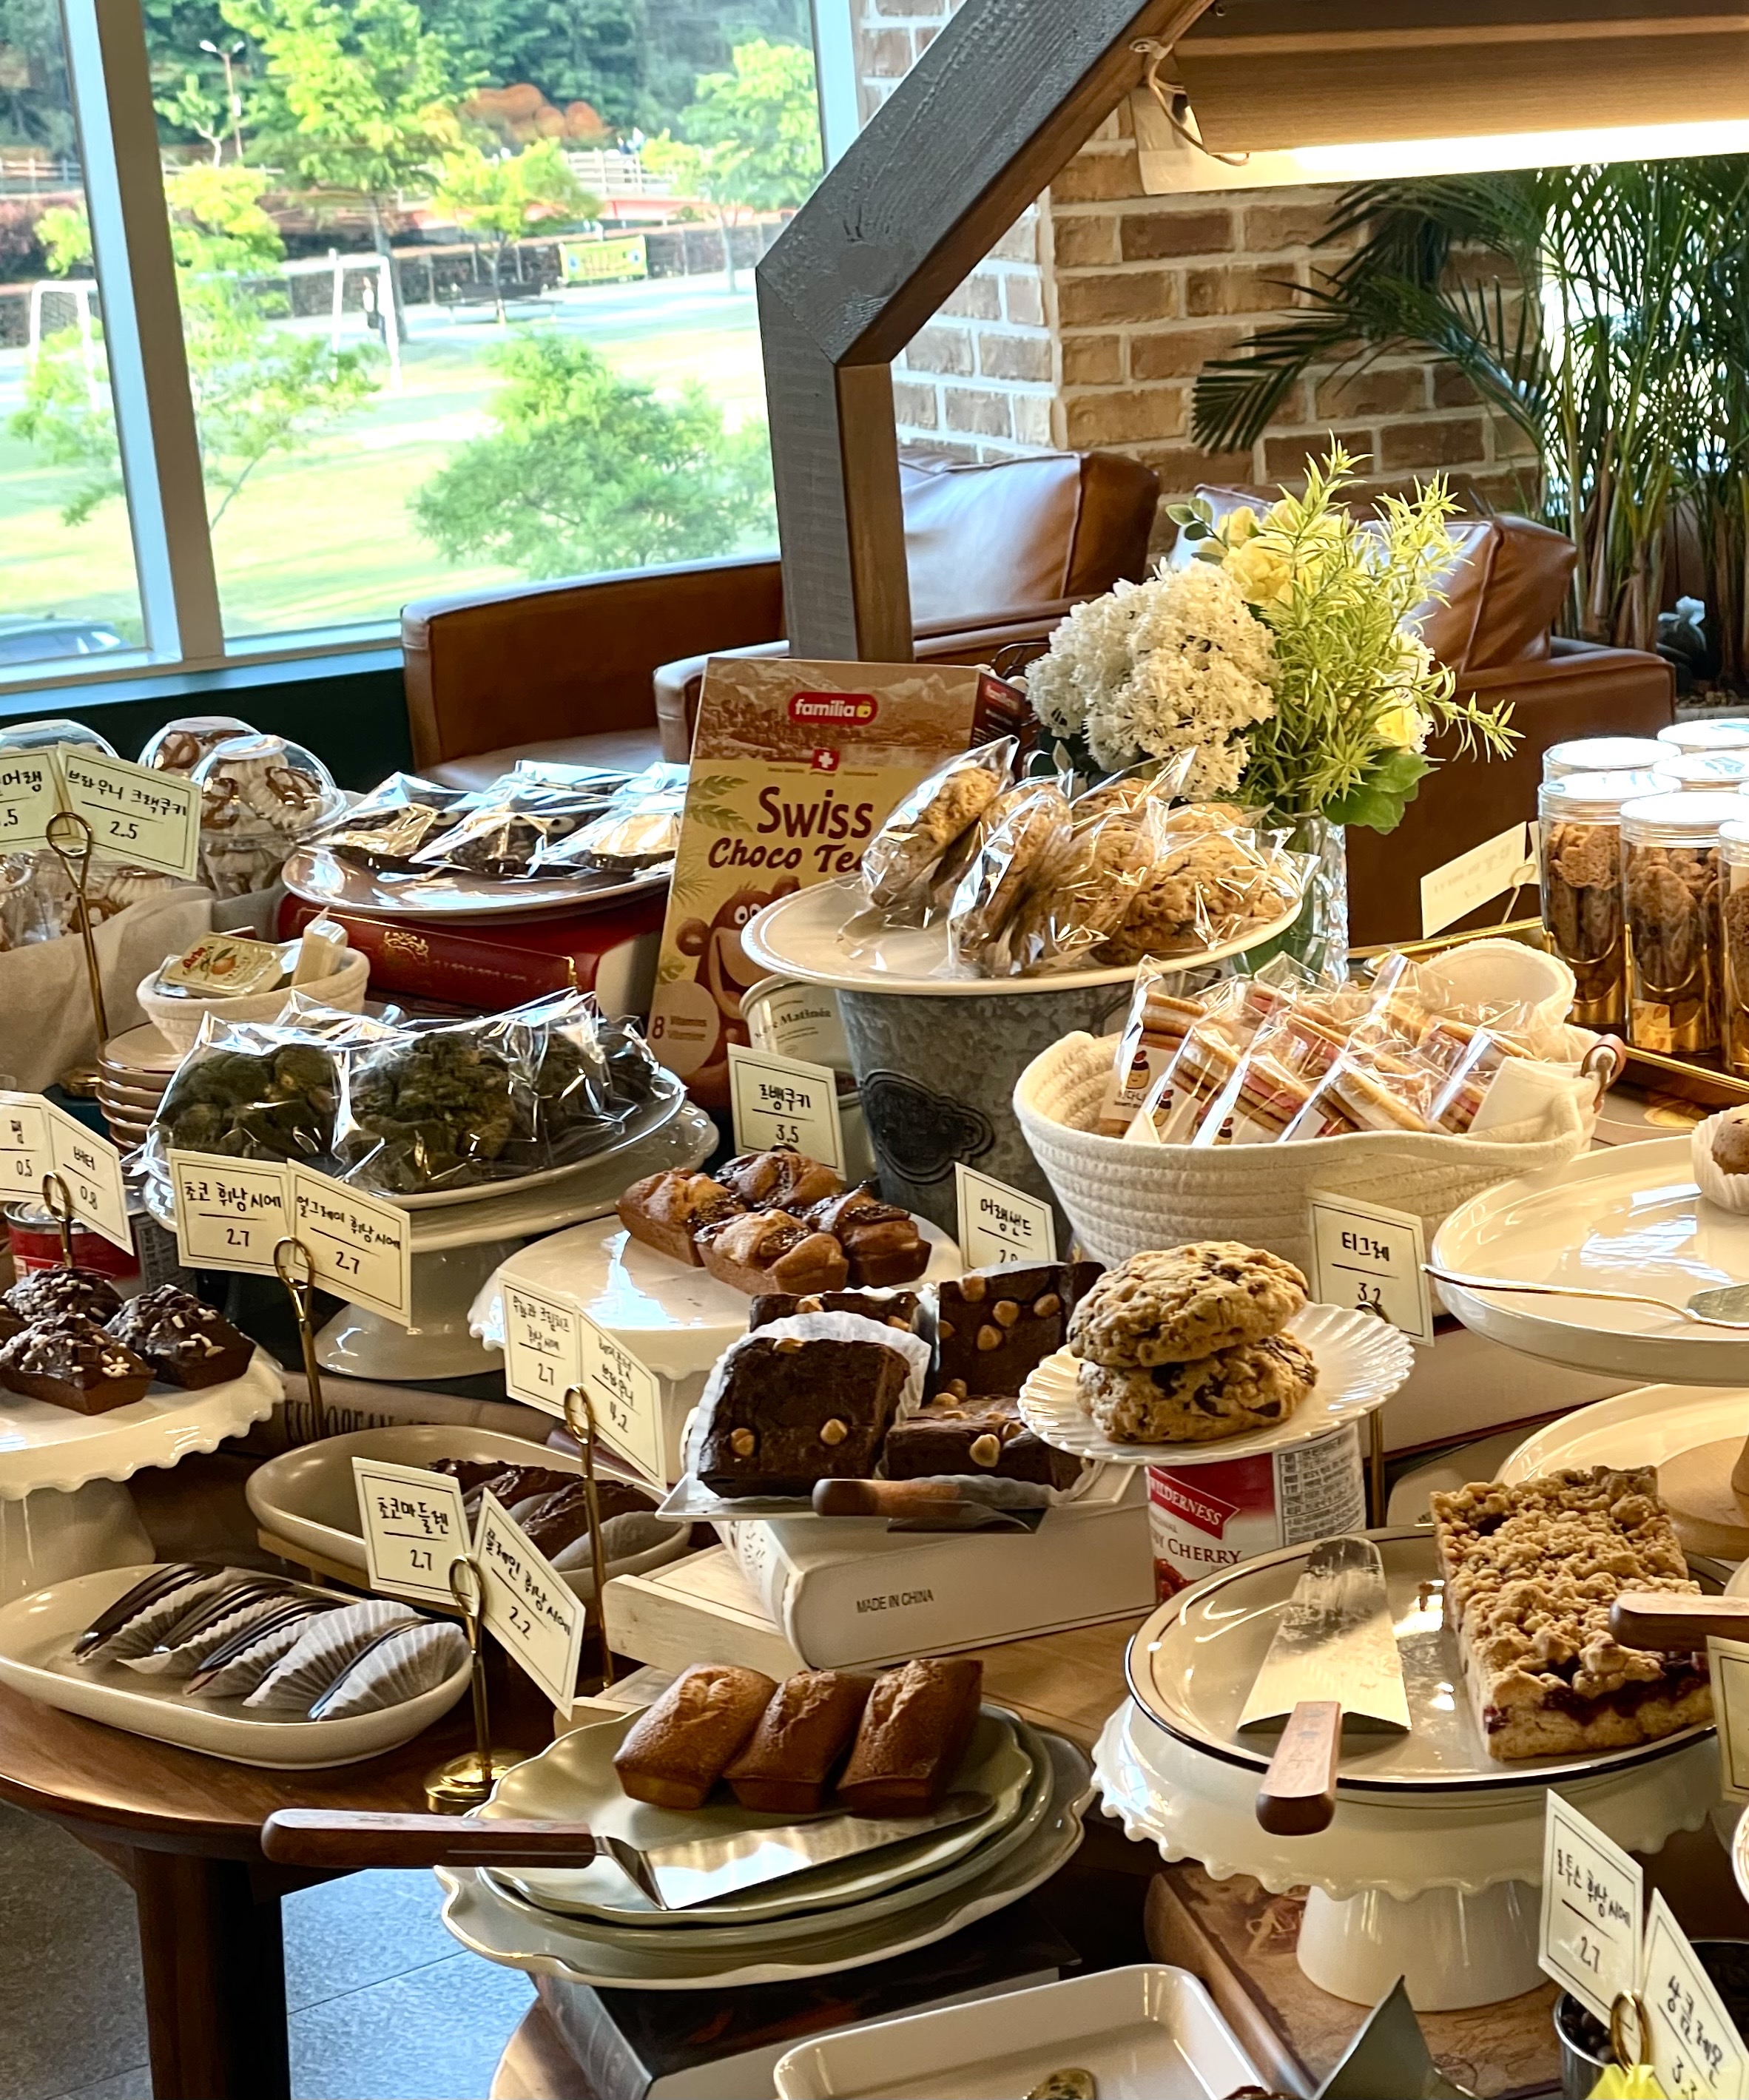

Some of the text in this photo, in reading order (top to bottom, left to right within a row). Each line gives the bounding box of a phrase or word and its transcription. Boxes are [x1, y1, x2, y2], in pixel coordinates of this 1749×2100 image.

[795, 699, 855, 718] familia
[0, 769, 43, 796] 머랭
[67, 769, 187, 817] 브라우니 크랙쿠키
[0, 808, 18, 827] .5
[757, 786, 874, 840] Swiss
[109, 821, 139, 840] 2.5
[708, 837, 803, 869] Choco
[652, 1016, 664, 1039] 8
[758, 1084, 811, 1112] 르뱅쿠키
[775, 1124, 799, 1143] 3.5
[184, 1181, 282, 1212] 초코 휘낭시에
[297, 1195, 401, 1250] 얼그레이 휘낭시에
[980, 1198, 1032, 1237] 머랭샌드
[226, 1228, 249, 1247] 2.7
[1341, 1231, 1389, 1262] 티그레
[335, 1251, 360, 1274] 2.7
[610, 1400, 629, 1434] 4.2
[377, 1496, 448, 1535] 초코마들렌
[410, 1549, 432, 1571] 2.7
[1167, 1538, 1242, 1564] CHERRY
[856, 1588, 934, 1613] MADE IN CHINA
[509, 1605, 530, 1641] 2.2
